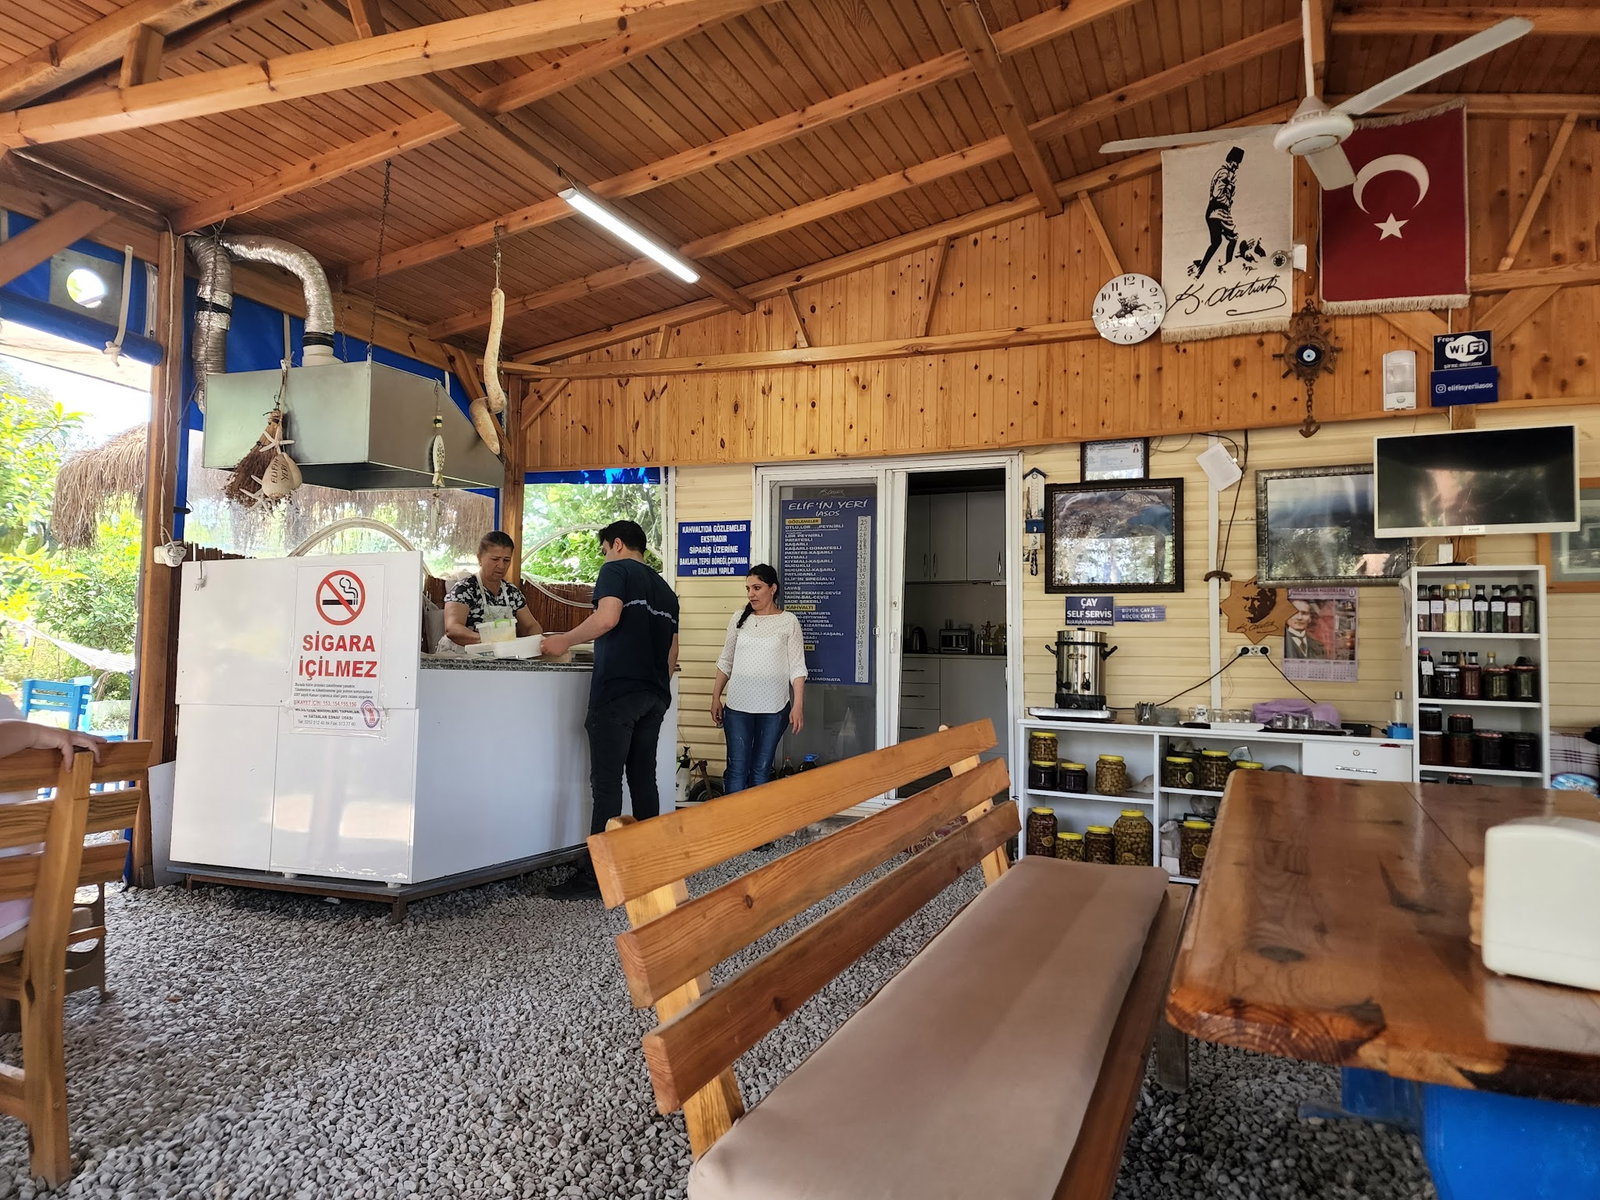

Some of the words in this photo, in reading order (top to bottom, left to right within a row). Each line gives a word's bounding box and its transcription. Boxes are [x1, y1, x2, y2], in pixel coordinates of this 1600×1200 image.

[1124, 276, 1135, 286] 12
[1112, 282, 1118, 292] 11
[1149, 287, 1158, 297] 2
[1101, 292, 1110, 302] 10
[1096, 306, 1104, 316] 9
[1112, 329, 1119, 338] 7
[1124, 331, 1132, 342] 6
[838, 499, 868, 508] YERİ
[682, 525, 712, 533] KAHVALTIDA
[713, 523, 746, 532] GÖZLEMELER
[701, 535, 727, 543] EKSTRADIR
[689, 545, 712, 555] SİPARİŞ
[713, 544, 738, 553] ÜZERİNE
[1080, 598, 1098, 609] ÇAY
[1084, 608, 1112, 618] SERVİS
[303, 631, 376, 652] SİGARA
[298, 656, 378, 680] İÇİLMEZ
